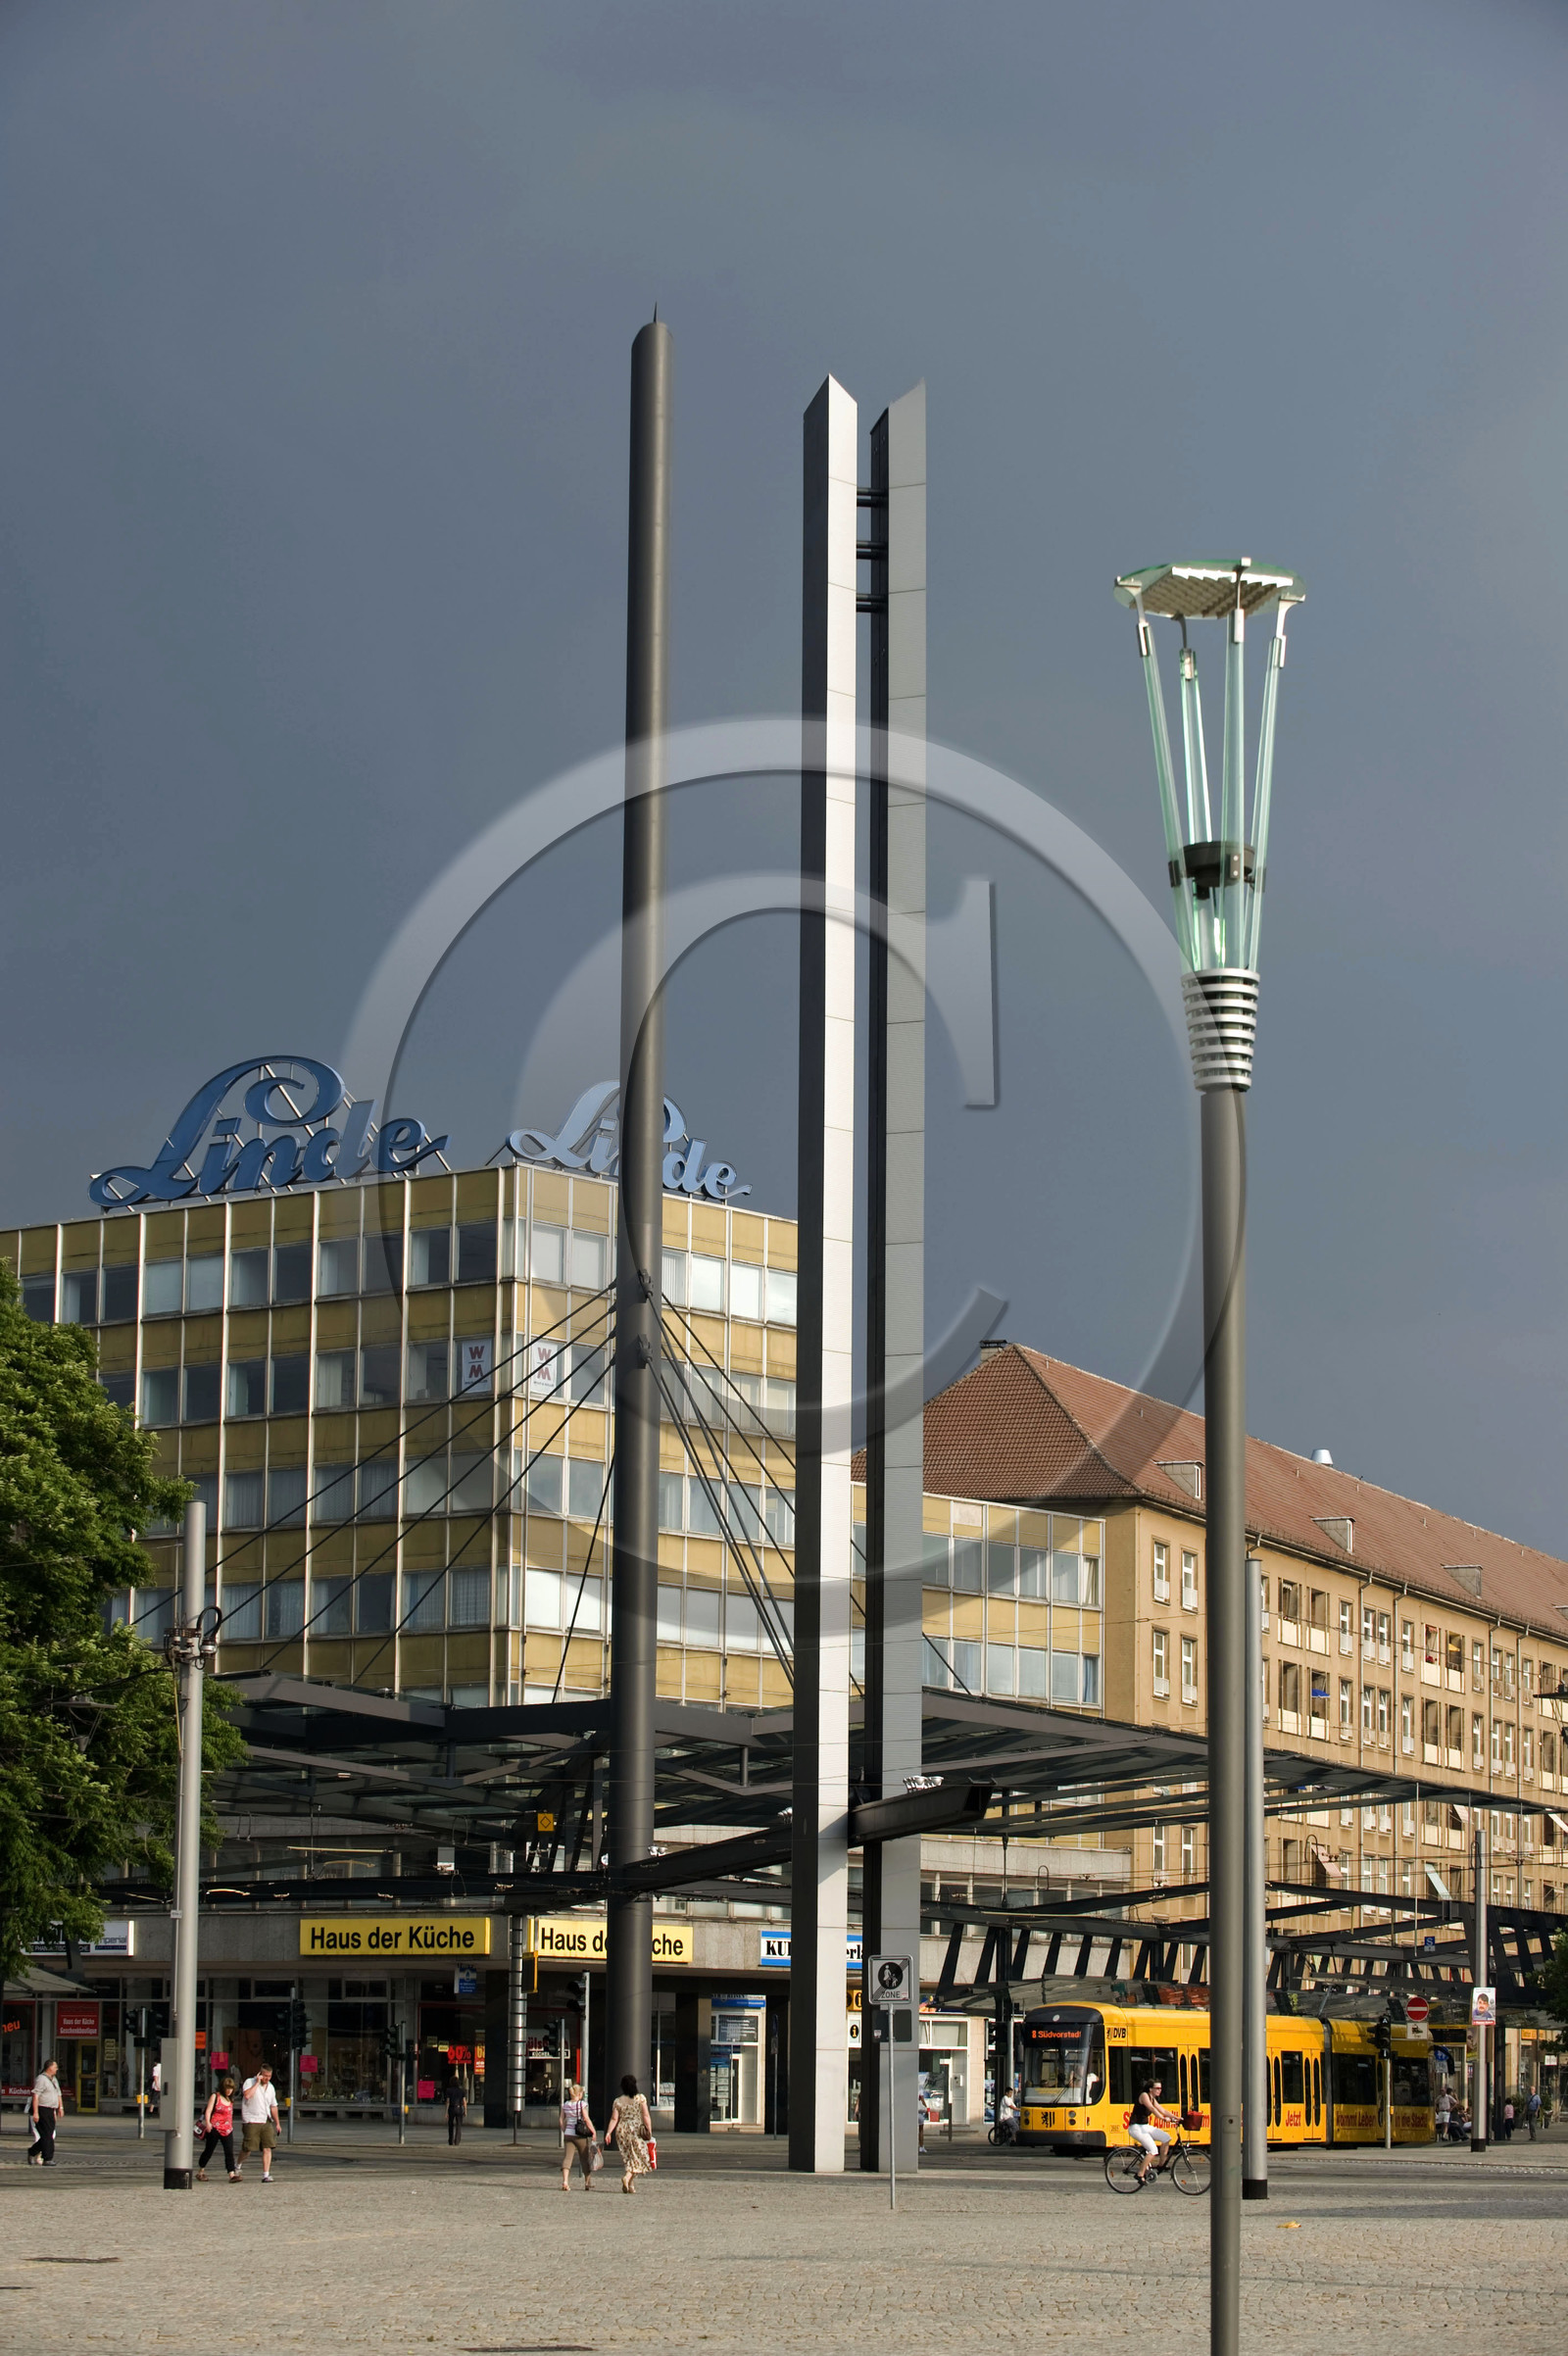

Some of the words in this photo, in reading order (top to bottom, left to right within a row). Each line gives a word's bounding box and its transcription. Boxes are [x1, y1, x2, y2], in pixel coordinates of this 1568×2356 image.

[86, 1054, 452, 1208] Linde
[506, 1079, 753, 1200] Lide
[311, 1927, 361, 1948] Haus
[367, 1926, 401, 1947] der
[408, 1925, 475, 1947] Küche
[541, 1928, 587, 1951] Haus
[1038, 2029, 1082, 2038] Südvorstadt
[1113, 2027, 1127, 2038] DVB
[1285, 2110, 1299, 2127] Jetzt
